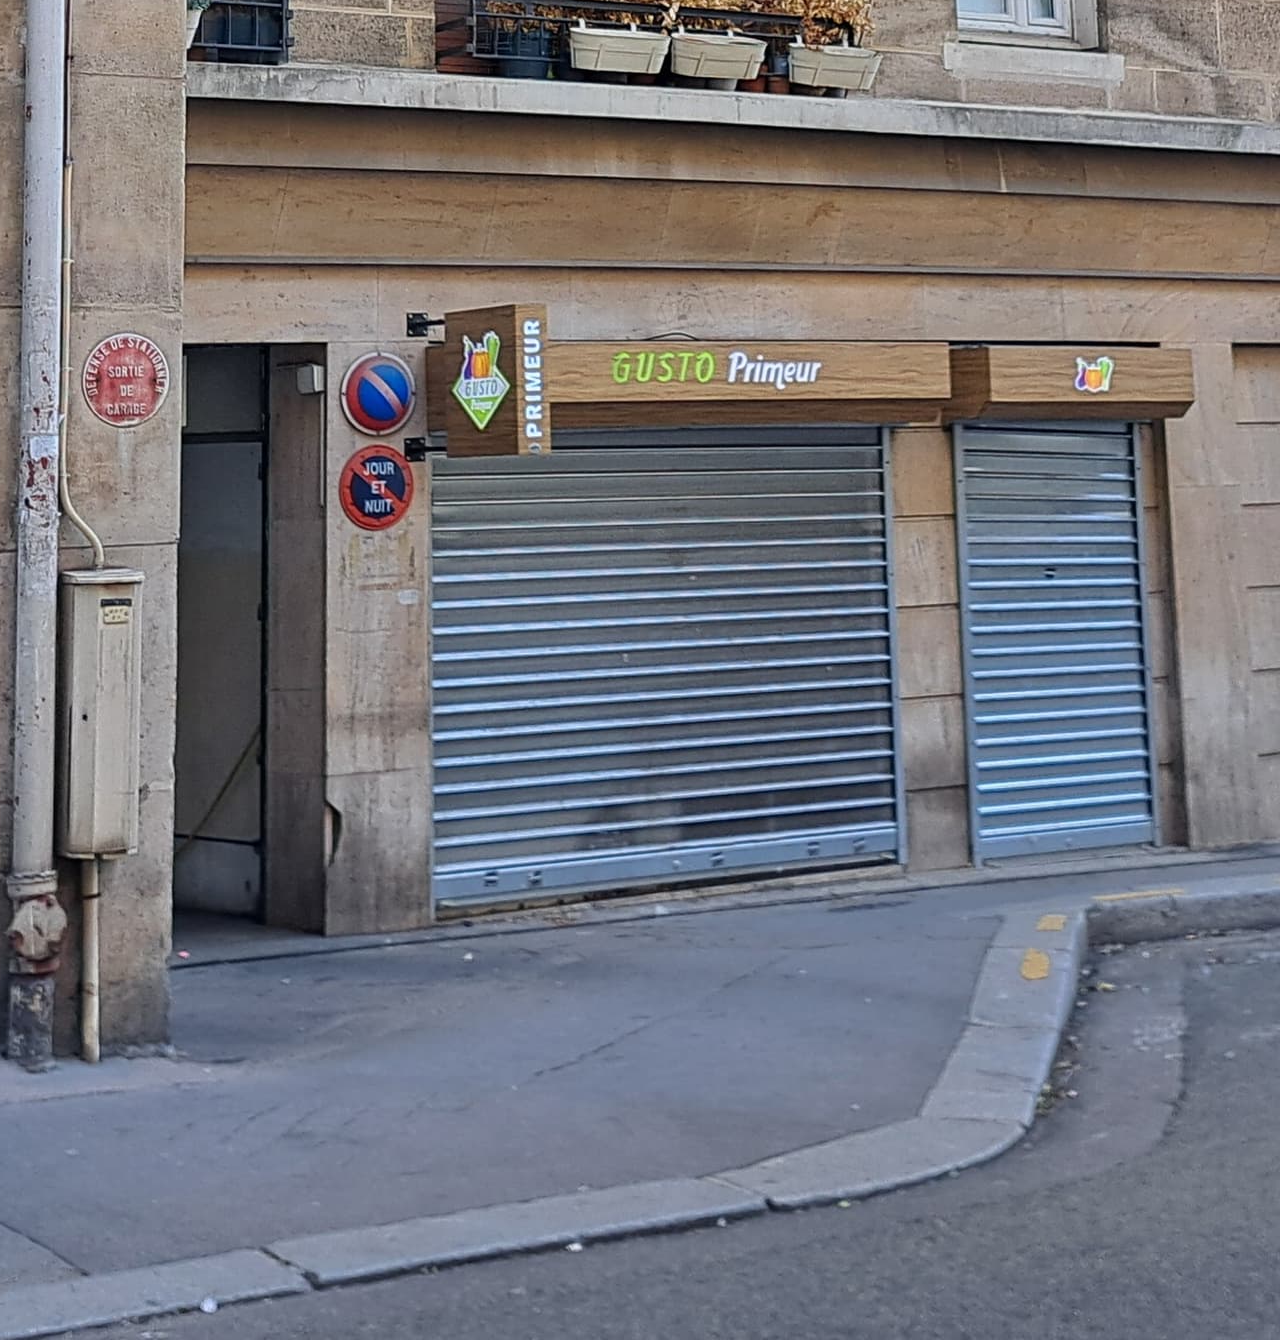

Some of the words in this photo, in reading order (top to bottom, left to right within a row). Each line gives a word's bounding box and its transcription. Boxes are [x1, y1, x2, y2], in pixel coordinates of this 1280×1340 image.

[108, 365, 145, 378] SORTIE
[110, 338, 125, 351] DE
[127, 337, 166, 395] STATIONNER
[612, 351, 715, 384] GUSTO
[727, 351, 822, 390] Primeur
[523, 319, 543, 438] PRIMEUR
[120, 384, 134, 397] DE
[465, 379, 498, 397] GUSTO
[363, 461, 395, 476] JOUR
[371, 480, 387, 494] ET
[364, 498, 393, 513] NUIT
